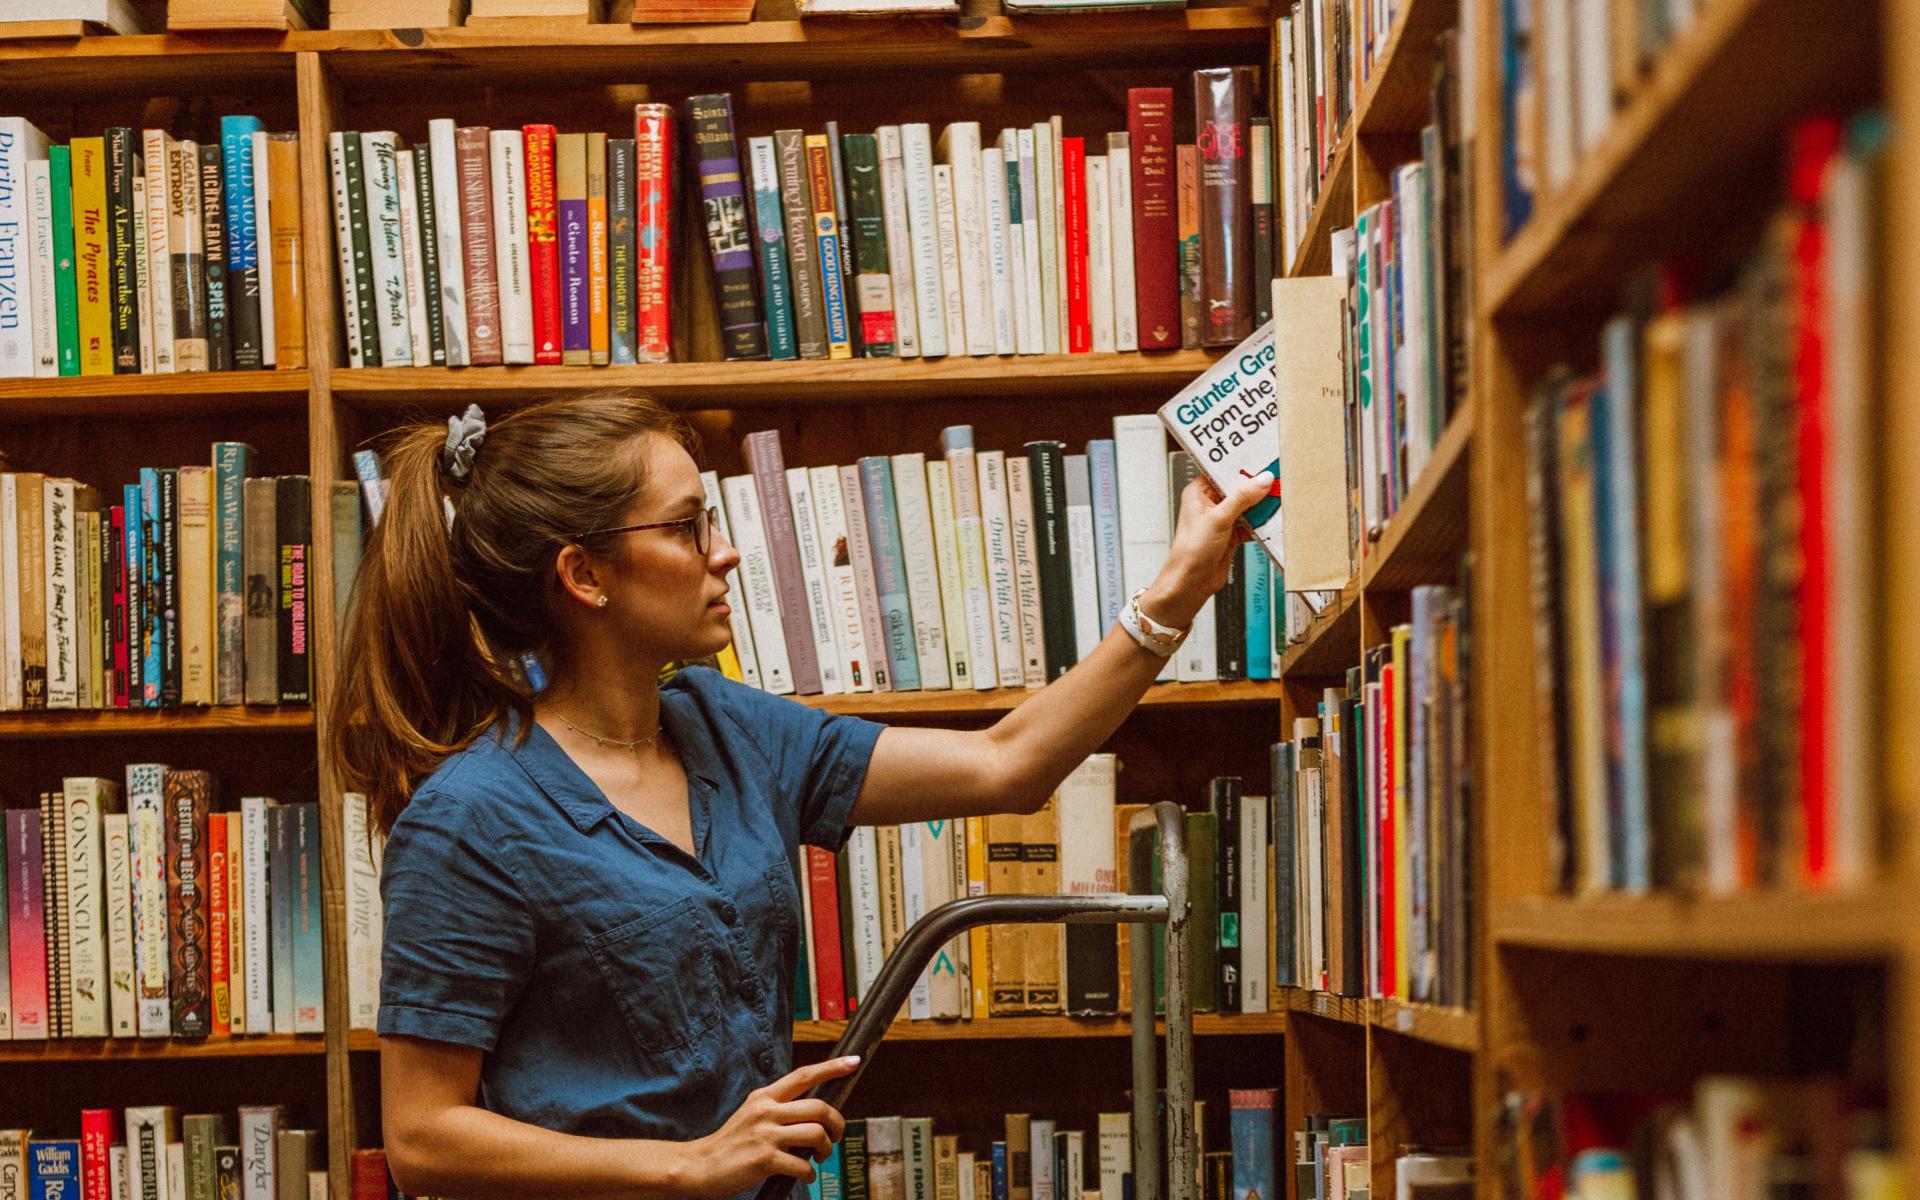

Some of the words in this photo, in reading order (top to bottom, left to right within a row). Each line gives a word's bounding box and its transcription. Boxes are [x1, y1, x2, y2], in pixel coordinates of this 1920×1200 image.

[693, 107, 728, 120] Saints
[83, 149, 94, 177] Fraser
[112, 134, 122, 166] Michael
[226, 134, 239, 199] CHARLES
[239, 133, 254, 187] COLD
[372, 142, 396, 192] Elbowing
[616, 148, 625, 178] AMITAV
[639, 132, 652, 180] GHOSH
[783, 134, 804, 205] Storming
[811, 148, 826, 175] Denise
[914, 141, 926, 182] SIGHTS
[0, 131, 16, 209] Purity
[113, 168, 123, 193] Frayn
[145, 136, 163, 204] MICHAEL
[170, 150, 184, 218] ENTROPY
[183, 150, 196, 215] AGAINST
[527, 133, 542, 208] CHROMOSOME
[35, 175, 48, 211] Caro
[115, 205, 126, 215] A
[204, 165, 218, 217] MICHAEL
[384, 195, 398, 212] the
[418, 149, 431, 225] EXTRAORDINARY
[425, 228, 435, 265] PEOPLE
[616, 181, 626, 212] GHOSH
[815, 176, 827, 211] Giardina
[918, 188, 931, 229] UNSEEN
[84, 208, 99, 235] The
[133, 210, 143, 233] THE
[150, 207, 166, 254] FRAYN
[336, 190, 345, 232] BOOK
[342, 248, 349, 265] OF
[788, 207, 808, 262] Heaven
[991, 199, 1001, 231] ELLEN
[37, 216, 50, 260] Fraser
[116, 218, 130, 267] Landing
[135, 234, 145, 256] TIN
[206, 223, 221, 261] FRAYN
[229, 205, 241, 265] FRAZIER
[241, 195, 258, 297] MOUNTAIN
[347, 145, 361, 229] SYLVIE
[357, 251, 373, 357] GERMAIN
[380, 213, 400, 259] Seducer
[567, 222, 580, 264] Circle
[615, 244, 626, 264] THE
[822, 237, 836, 272] GOOD
[921, 234, 934, 260] KAYE
[0, 221, 19, 329] Franzen
[83, 242, 101, 304] Pyrates
[136, 258, 146, 288] MEN
[843, 250, 852, 275] Moon
[993, 236, 1004, 275] FOSTER
[118, 269, 128, 283] on
[118, 285, 129, 304] the
[615, 267, 627, 307] HUNGRY
[639, 258, 652, 312] Poppies
[651, 264, 663, 288] Sea
[797, 269, 811, 318] GIARDINA
[827, 273, 840, 301] KING
[925, 266, 939, 321] GIBBONS
[209, 281, 224, 319] SPIES
[570, 277, 581, 325] Reason
[651, 292, 663, 304] of
[119, 306, 131, 330] Sun
[616, 310, 628, 332] TIDE
[830, 302, 846, 340] HARRY
[1176, 371, 1241, 425] Günter
[1239, 339, 1276, 376] Gra
[1190, 403, 1242, 447] From
[1240, 379, 1274, 408] the
[220, 447, 237, 472] Rip
[1041, 452, 1052, 475] ELLEN
[1208, 437, 1229, 463] of
[1229, 430, 1245, 447] a
[224, 473, 238, 499] Van
[869, 463, 886, 513] Victory
[987, 459, 999, 491] Gilchrist
[1043, 475, 1055, 514] GILCHRIST
[1100, 452, 1113, 510] GILCHRIST
[163, 474, 171, 518] Columbus
[224, 500, 239, 552] Winkle
[877, 515, 890, 548] Over
[990, 517, 1006, 565] Drunk
[1015, 518, 1031, 566] Drunk
[1104, 522, 1113, 530] A
[128, 530, 139, 581] COLUMBUS
[163, 522, 172, 571] Slaughters
[292, 544, 304, 560] THE
[1104, 531, 1117, 598] DANGEROUS
[165, 575, 173, 606] Braves
[292, 562, 304, 585] ROAD
[879, 554, 896, 593] Again
[994, 568, 1012, 606] With
[1020, 569, 1037, 608] With
[292, 587, 304, 600] TO
[968, 587, 982, 612] Ellen
[1108, 600, 1118, 622] AGE
[129, 584, 140, 645] SLAUGHTERS
[840, 575, 861, 652] RHODA
[998, 609, 1013, 644] Love
[1023, 612, 1038, 646] Love
[889, 608, 907, 662] Gilchrist
[916, 621, 928, 656] Gilchrist
[930, 626, 940, 647] Ellen
[972, 614, 986, 658] Gilchrist
[130, 648, 140, 686] BRAVES
[178, 798, 192, 842] DESTINY
[248, 807, 257, 825] The
[248, 828, 257, 867] Crystal
[955, 833, 964, 886] ELPENOR
[69, 798, 91, 945] CONSTANCIA
[111, 834, 127, 944] CONSTANCIA
[180, 859, 194, 897] DESIRE
[209, 851, 224, 907] CARLOS
[1095, 869, 1116, 882] ONE
[147, 889, 156, 929] CARLOS
[249, 871, 258, 916] Frontier
[183, 906, 194, 944] CARLOS
[211, 910, 224, 974] FUENTES
[250, 925, 258, 957] CARLOS
[148, 932, 158, 981] FUENTES
[185, 946, 195, 987] FUENTES
[251, 961, 259, 1000] FUENTES
[215, 984, 230, 1020] USED
[36, 1146, 71, 1161] William
[96, 1131, 105, 1162] JUST
[191, 1134, 200, 1156] the
[248, 1123, 271, 1191] Dangler
[845, 1136, 864, 1154] THE
[911, 1126, 922, 1163] YEARS
[38, 1161, 70, 1175] Gaddis
